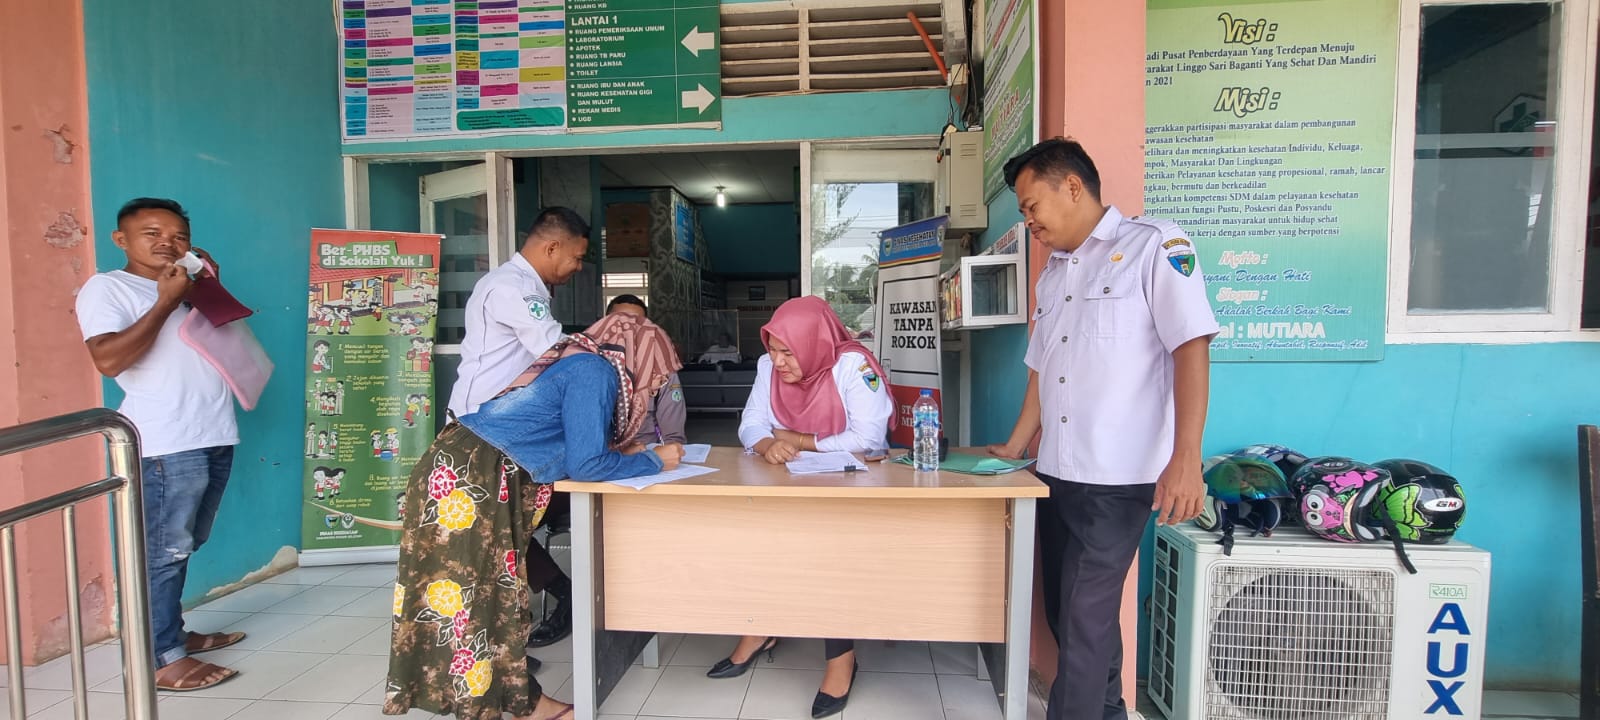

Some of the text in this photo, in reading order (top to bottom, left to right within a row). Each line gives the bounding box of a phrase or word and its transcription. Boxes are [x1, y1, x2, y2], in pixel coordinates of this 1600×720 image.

[571, 16, 608, 26] LANTAI
[1218, 12, 1265, 44] Visi
[1162, 51, 1185, 59] Pusat
[1189, 47, 1247, 59] Penberdayaan
[1251, 47, 1273, 57] Yang
[1276, 45, 1317, 55] Terdepan
[1320, 43, 1355, 53] Menuju
[1176, 63, 1206, 73] Linggo
[1209, 62, 1227, 70] Sari
[1229, 60, 1263, 71] Baganti
[1265, 59, 1288, 69] Yang
[1291, 58, 1315, 67] Sehat
[1318, 57, 1336, 65] Dan
[1340, 55, 1376, 64] Mandiri
[1154, 76, 1173, 85] 2021
[1214, 87, 1269, 118] Misi
[1187, 122, 1226, 133] partisipasi
[1229, 121, 1272, 131] masyarakat
[1275, 121, 1299, 129] dalam
[1301, 119, 1356, 129] pembangunan
[1175, 134, 1214, 143] kesehatan
[1144, 147, 1173, 155] elihara
[1175, 146, 1189, 154] dan
[1192, 146, 1246, 154] meningkatkan
[1249, 144, 1287, 153] kesehatan
[1289, 143, 1325, 152] Individu,
[1170, 157, 1215, 168] Masyarakat
[1218, 157, 1234, 166] Dan
[1237, 157, 1282, 167] Lingkungan
[1177, 169, 1215, 179] Pelayanan
[1218, 168, 1256, 177] kesehatan
[1259, 169, 1276, 177] yang
[1279, 168, 1327, 178] propesional,
[1360, 166, 1385, 175] lancar
[1171, 182, 1203, 190] bermutu
[1222, 181, 1267, 189] berkeadilan
[1184, 194, 1227, 204] kompetensi
[1279, 192, 1317, 202] pelayanan
[1320, 191, 1359, 199] kesehatan
[1192, 205, 1215, 215] fungsi
[1217, 205, 1241, 213] Pustu,
[1296, 204, 1332, 213] Posyandu
[1222, 216, 1266, 225] masyarakat
[1293, 216, 1315, 224] hidup
[1318, 215, 1338, 223] sehat
[1197, 229, 1217, 238] kerja
[1219, 229, 1246, 238] dengan
[1248, 229, 1276, 237] sumber
[1279, 229, 1297, 237] yang
[1298, 228, 1339, 237] berpotensi
[321, 244, 390, 256] Ber-PHBS
[323, 257, 336, 266] di
[339, 256, 387, 266] Sekolah
[391, 255, 415, 266] Yuk
[1235, 270, 1277, 283] Dengan
[1284, 270, 1312, 281] Hati
[1215, 306, 1351, 316] Adalah Berkah Bagi Kami
[894, 318, 933, 331] TANPA
[1247, 322, 1325, 338] MUTIARA
[892, 336, 936, 348] ROKOK
[902, 405, 914, 414] ST
[1432, 585, 1465, 598] R410A
[1424, 603, 1471, 715] AUX
